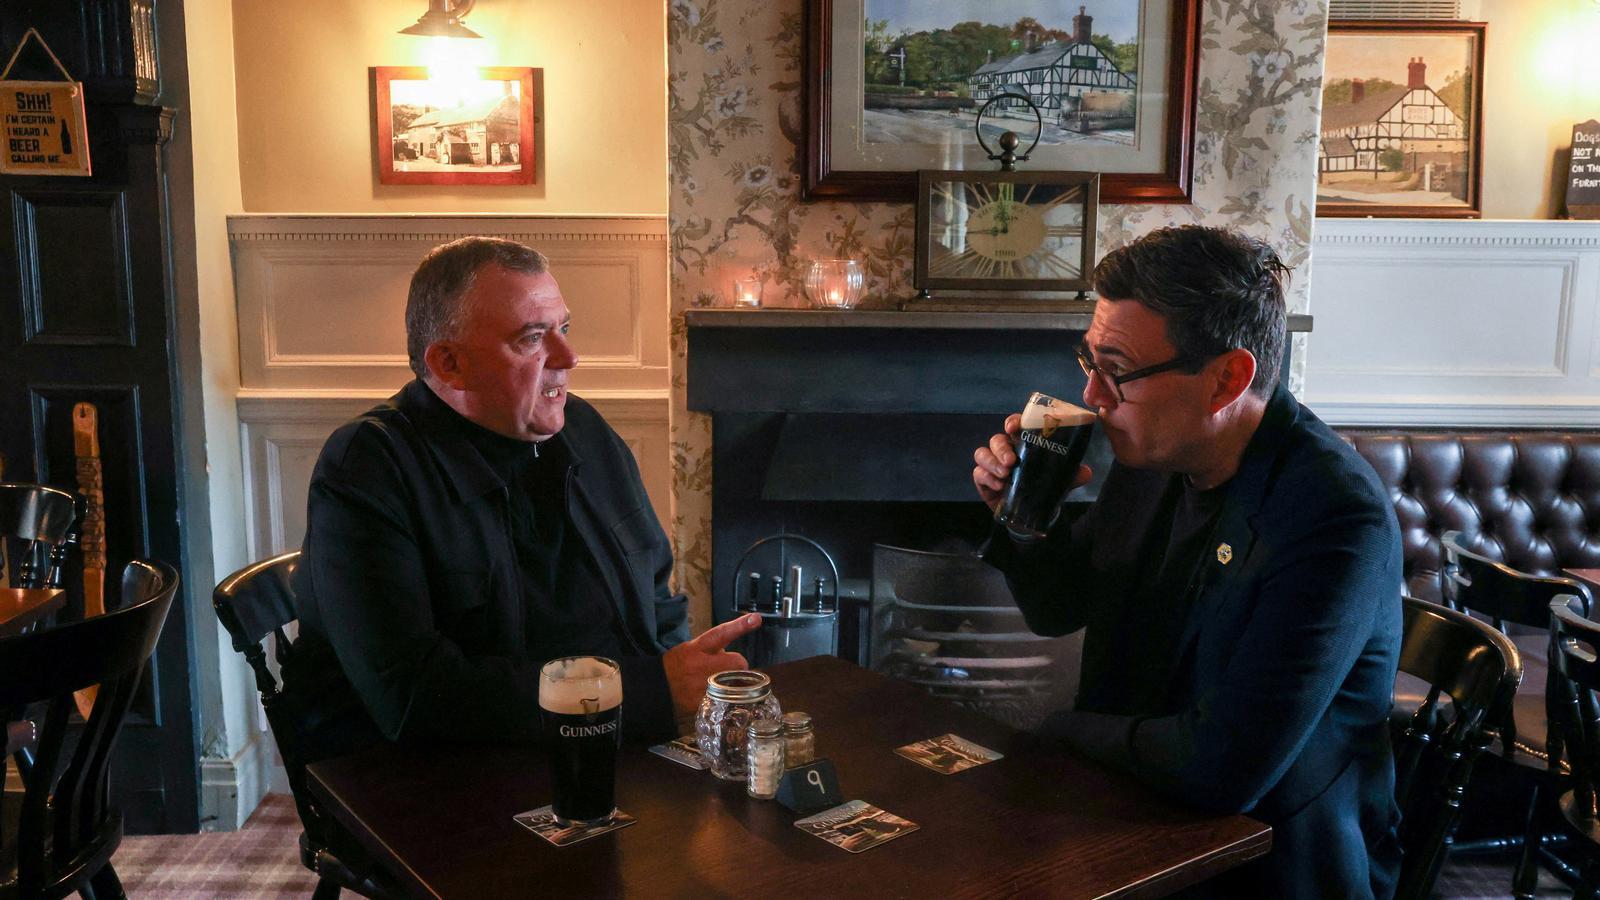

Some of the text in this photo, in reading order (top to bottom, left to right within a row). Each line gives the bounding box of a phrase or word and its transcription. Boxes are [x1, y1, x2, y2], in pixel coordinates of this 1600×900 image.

[15, 91, 52, 110] SHH!
[6, 114, 56, 124] I'M CERTAIN
[12, 127, 40, 136] HEARD
[43, 127, 49, 137] A
[9, 138, 40, 152] BEER
[1573, 147, 1593, 157] NOT
[11, 154, 60, 163] CALLING ME
[1571, 164, 1584, 173] ON
[1020, 430, 1069, 456] GUINNESS
[559, 719, 617, 737] GUINNESS
[807, 769, 825, 794] 9
